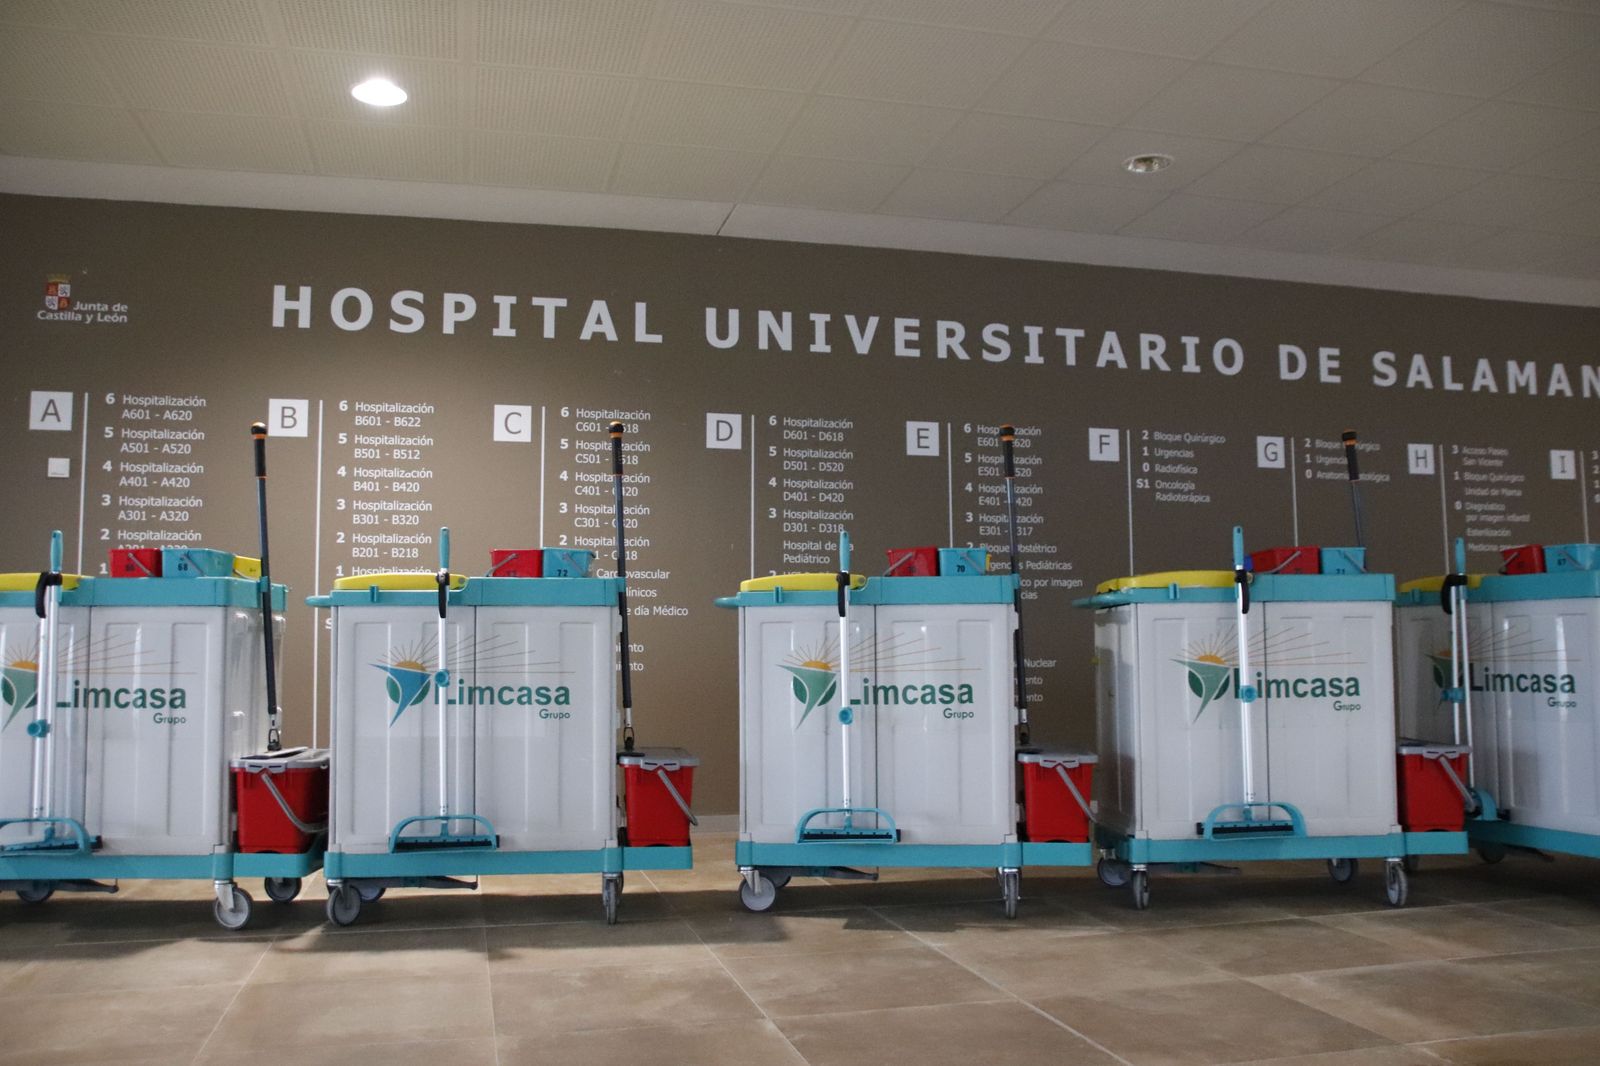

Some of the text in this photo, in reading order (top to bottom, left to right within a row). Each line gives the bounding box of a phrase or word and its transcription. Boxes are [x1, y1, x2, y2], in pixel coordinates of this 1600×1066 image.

[74, 302, 128, 312] Junta de
[38, 310, 127, 324] Castilla y León
[272, 285, 1600, 397] HOSPITAL UNIVERSITARIO DE SALAMAN
[106, 393, 206, 407] 6 Hospitalización
[41, 399, 60, 422] A
[340, 400, 434, 414] 6 Hospitalización
[122, 409, 192, 420] A601 A620
[281, 406, 297, 428] B
[561, 407, 650, 420] 6 Hospitalización
[355, 416, 420, 427] B601 B622
[504, 412, 521, 434] C
[576, 422, 600, 432] C601
[770, 416, 853, 428] 6 Hospitalización
[104, 427, 204, 440] 5 Hospitalización
[716, 420, 733, 441] D
[964, 424, 971, 433] 6
[338, 433, 433, 446] 5 Hospitalización
[784, 430, 844, 441] D601 D618
[917, 428, 930, 448] E
[1142, 430, 1148, 440] 2
[1154, 432, 1182, 442] Bloque
[560, 439, 650, 453] 5 Hospitazación
[978, 437, 998, 447] E601
[1099, 434, 1110, 454] F
[1305, 438, 1311, 447] 2
[120, 443, 191, 454] A501 A520
[354, 448, 420, 459] B501 B512
[770, 446, 853, 459] 5 Hospitalización
[1143, 446, 1194, 458] 1 Urgencias
[1264, 442, 1278, 462] G
[576, 454, 600, 463] C501
[965, 453, 972, 462] 5
[1306, 454, 1311, 463] 1
[1416, 450, 1427, 468] H
[103, 461, 204, 474] 4 Hospitalización
[784, 461, 844, 472] D501 D520
[1143, 462, 1150, 472] 0
[1560, 456, 1566, 473] I
[338, 466, 432, 479] 4 Hospitalización
[978, 466, 1000, 476] E501
[1306, 469, 1312, 478] 0
[1454, 471, 1460, 480] 1
[120, 476, 190, 488] A401 A420
[560, 471, 650, 484] 4 Hospitaación
[1136, 478, 1150, 488] S1
[354, 481, 420, 492] B401 B420
[769, 477, 853, 490] 4 Hospitalización
[965, 483, 972, 492] 4
[575, 486, 600, 495] C401
[102, 494, 202, 508] 3 Hospitalización
[784, 492, 844, 502] D401 D420
[979, 496, 1000, 506] E401
[337, 499, 432, 512] 3 Hospitalización
[560, 502, 650, 516] 3 Hospitalación
[118, 510, 189, 521] A301 A320
[353, 514, 419, 525] B301 B320
[769, 508, 853, 520] 3 Hospitalización
[966, 512, 973, 522] 3
[574, 518, 600, 527] C301
[784, 522, 808, 532] D301
[101, 528, 202, 542] 2 Hospitalización
[980, 526, 1000, 535] E301
[336, 532, 432, 545] 2 Hospitalización
[560, 535, 650, 548] 2 Hospitalación
[784, 540, 822, 552] Hospital
[824, 542, 836, 550] de
[1016, 544, 1056, 554] bstétrico
[352, 548, 418, 558] B201 B218
[784, 554, 830, 564] Pediátrico
[100, 563, 108, 574] 1
[1026, 560, 1072, 570] Pediátricas
[336, 566, 344, 576] 1
[1034, 580, 1048, 588] por
[626, 587, 657, 597] línicos
[634, 605, 688, 616] día Médico
[1024, 658, 1056, 668] Nuclear
[1471, 662, 1576, 694] Limcasa
[56, 680, 186, 708] imcasa
[850, 678, 974, 705] imcasa
[1334, 701, 1361, 713] Grupo
[1547, 697, 1577, 709] Grupo
[153, 712, 186, 725] Grupo
[539, 709, 570, 720] Grupo
[943, 708, 974, 719] Grupo
